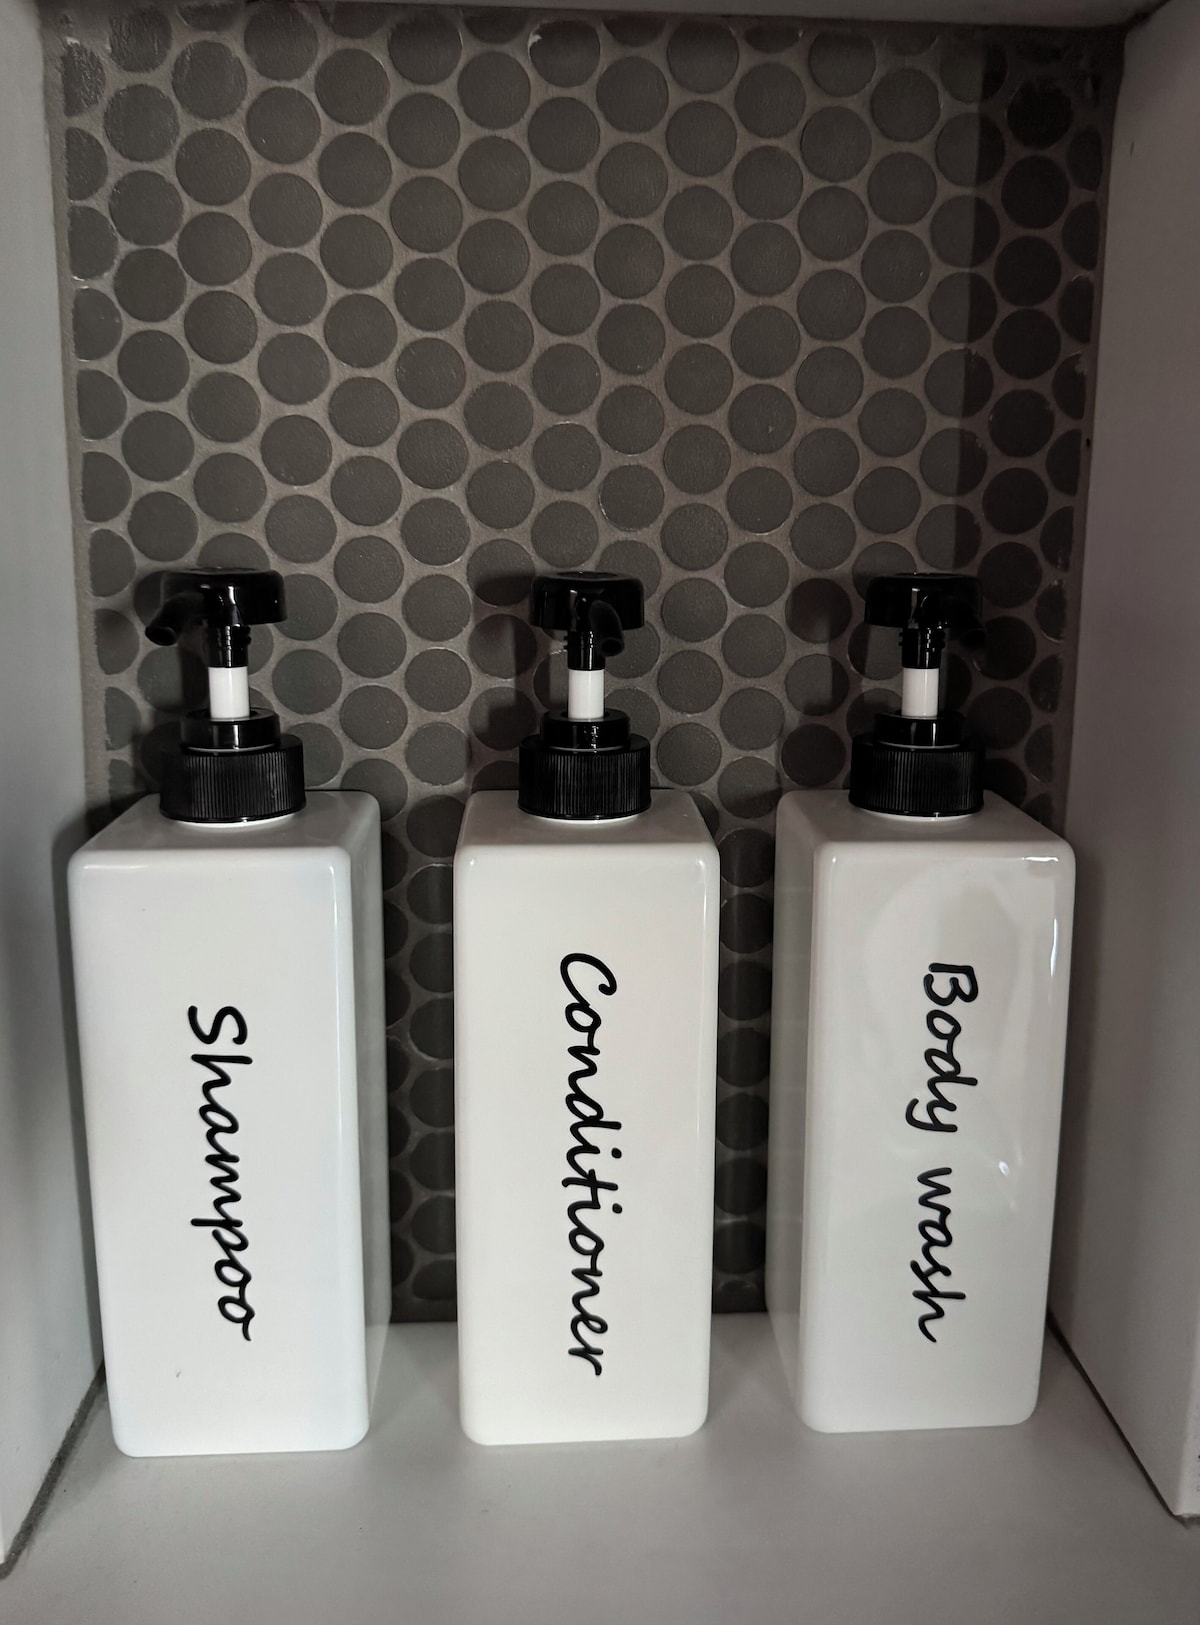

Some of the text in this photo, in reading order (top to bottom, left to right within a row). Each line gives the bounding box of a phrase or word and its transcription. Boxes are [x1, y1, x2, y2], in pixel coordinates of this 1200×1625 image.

[187, 1005, 255, 1342] Shampoo
[559, 952, 623, 1377] Conditioner
[905, 962, 979, 1344] Body wash
